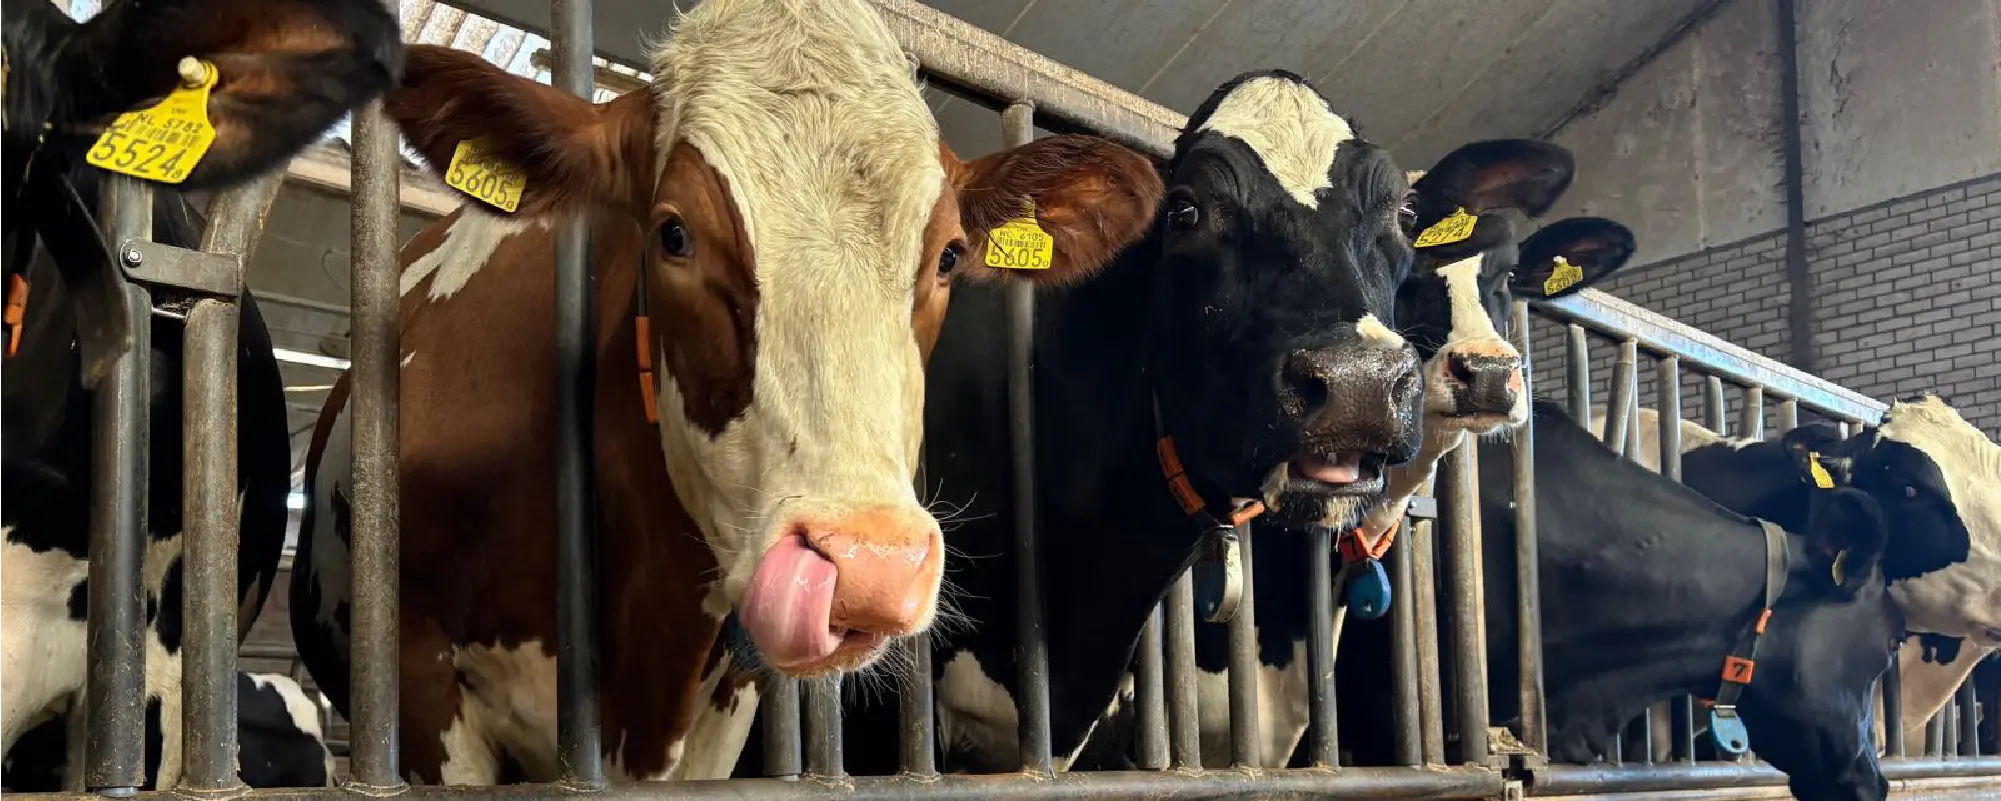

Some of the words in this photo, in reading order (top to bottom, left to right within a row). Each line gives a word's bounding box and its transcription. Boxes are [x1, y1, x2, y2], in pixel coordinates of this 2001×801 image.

[93, 132, 188, 177] 5524
[451, 159, 512, 204] 5605
[989, 245, 1043, 267] 5605
[1732, 662, 1747, 678] 7
